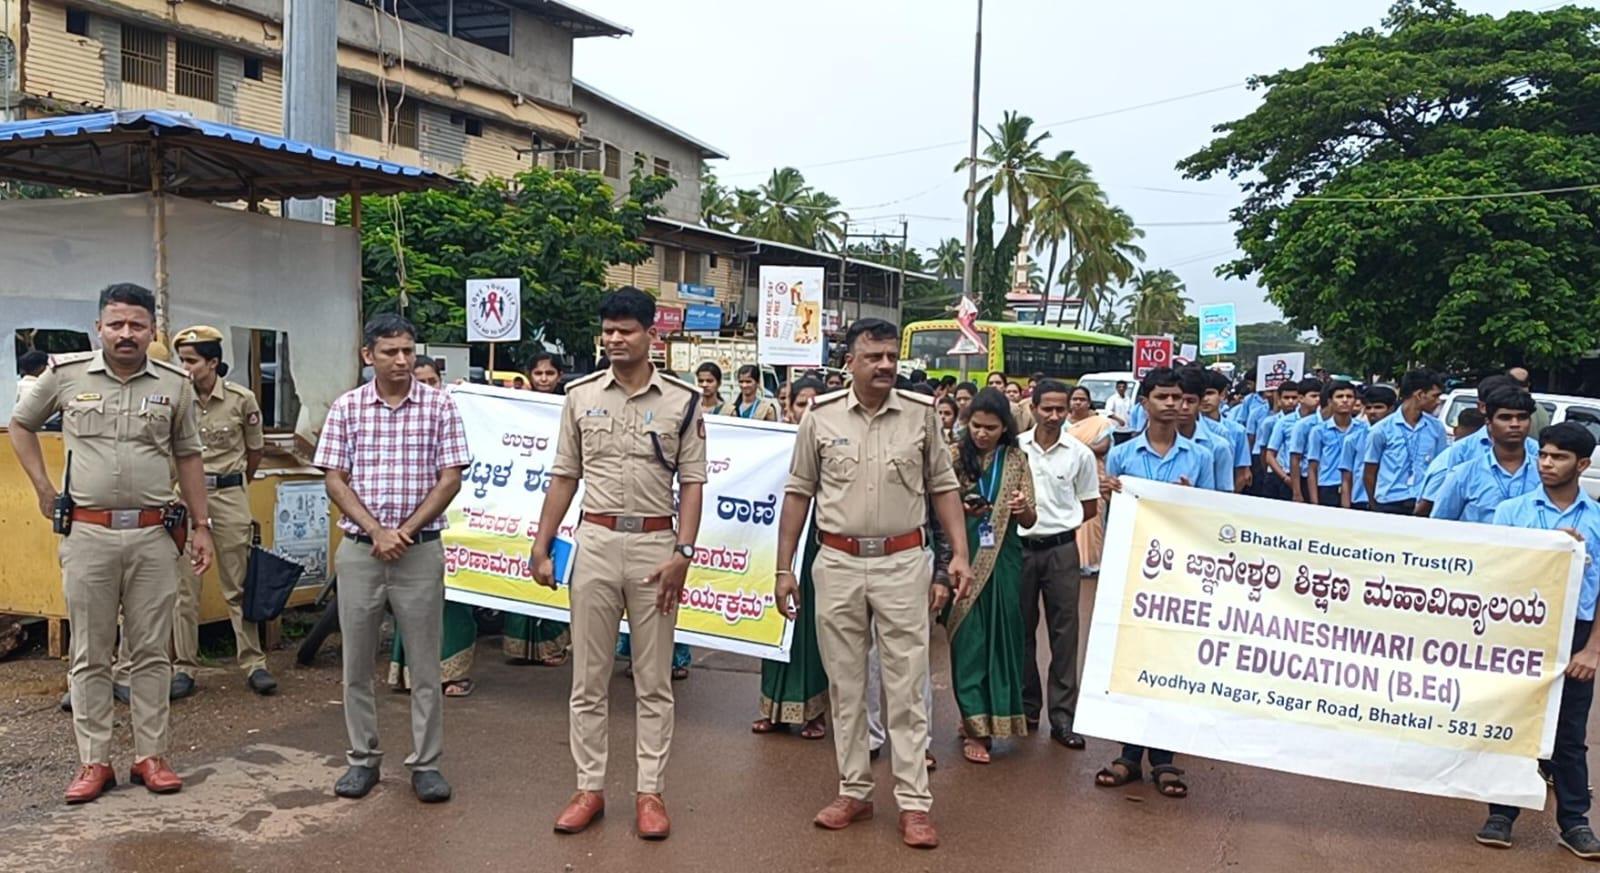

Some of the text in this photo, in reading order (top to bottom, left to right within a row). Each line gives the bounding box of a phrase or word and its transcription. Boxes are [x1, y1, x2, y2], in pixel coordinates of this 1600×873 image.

[1141, 348, 1166, 362] NO
[502, 433, 549, 457] ಉತ್ತರ
[717, 493, 778, 526] ಠಾಣೆ
[1240, 530, 1474, 575] Bhatkal Education Trust(R)
[1142, 539, 1546, 635] ಶ್ರೀ ಜ್ಞಾನೇಶ್ವರಿ ಶಿಕ್ಷಣ ಮಹಾವಿದ್ಯಾಲಯ
[1133, 592, 1544, 678] SHREE JNAANESHWARI COLLEGE
[1198, 638, 1461, 712] OF EDUCATION (B.Ed)
[1137, 670, 1206, 694] Ayodhya
[1210, 682, 1261, 705] Nagar,
[1266, 690, 1312, 711] Sagar
[1316, 699, 1363, 722] Road,
[1369, 707, 1432, 730] Bhatkal
[1448, 720, 1478, 737] 581
[1483, 724, 1514, 741] 320
